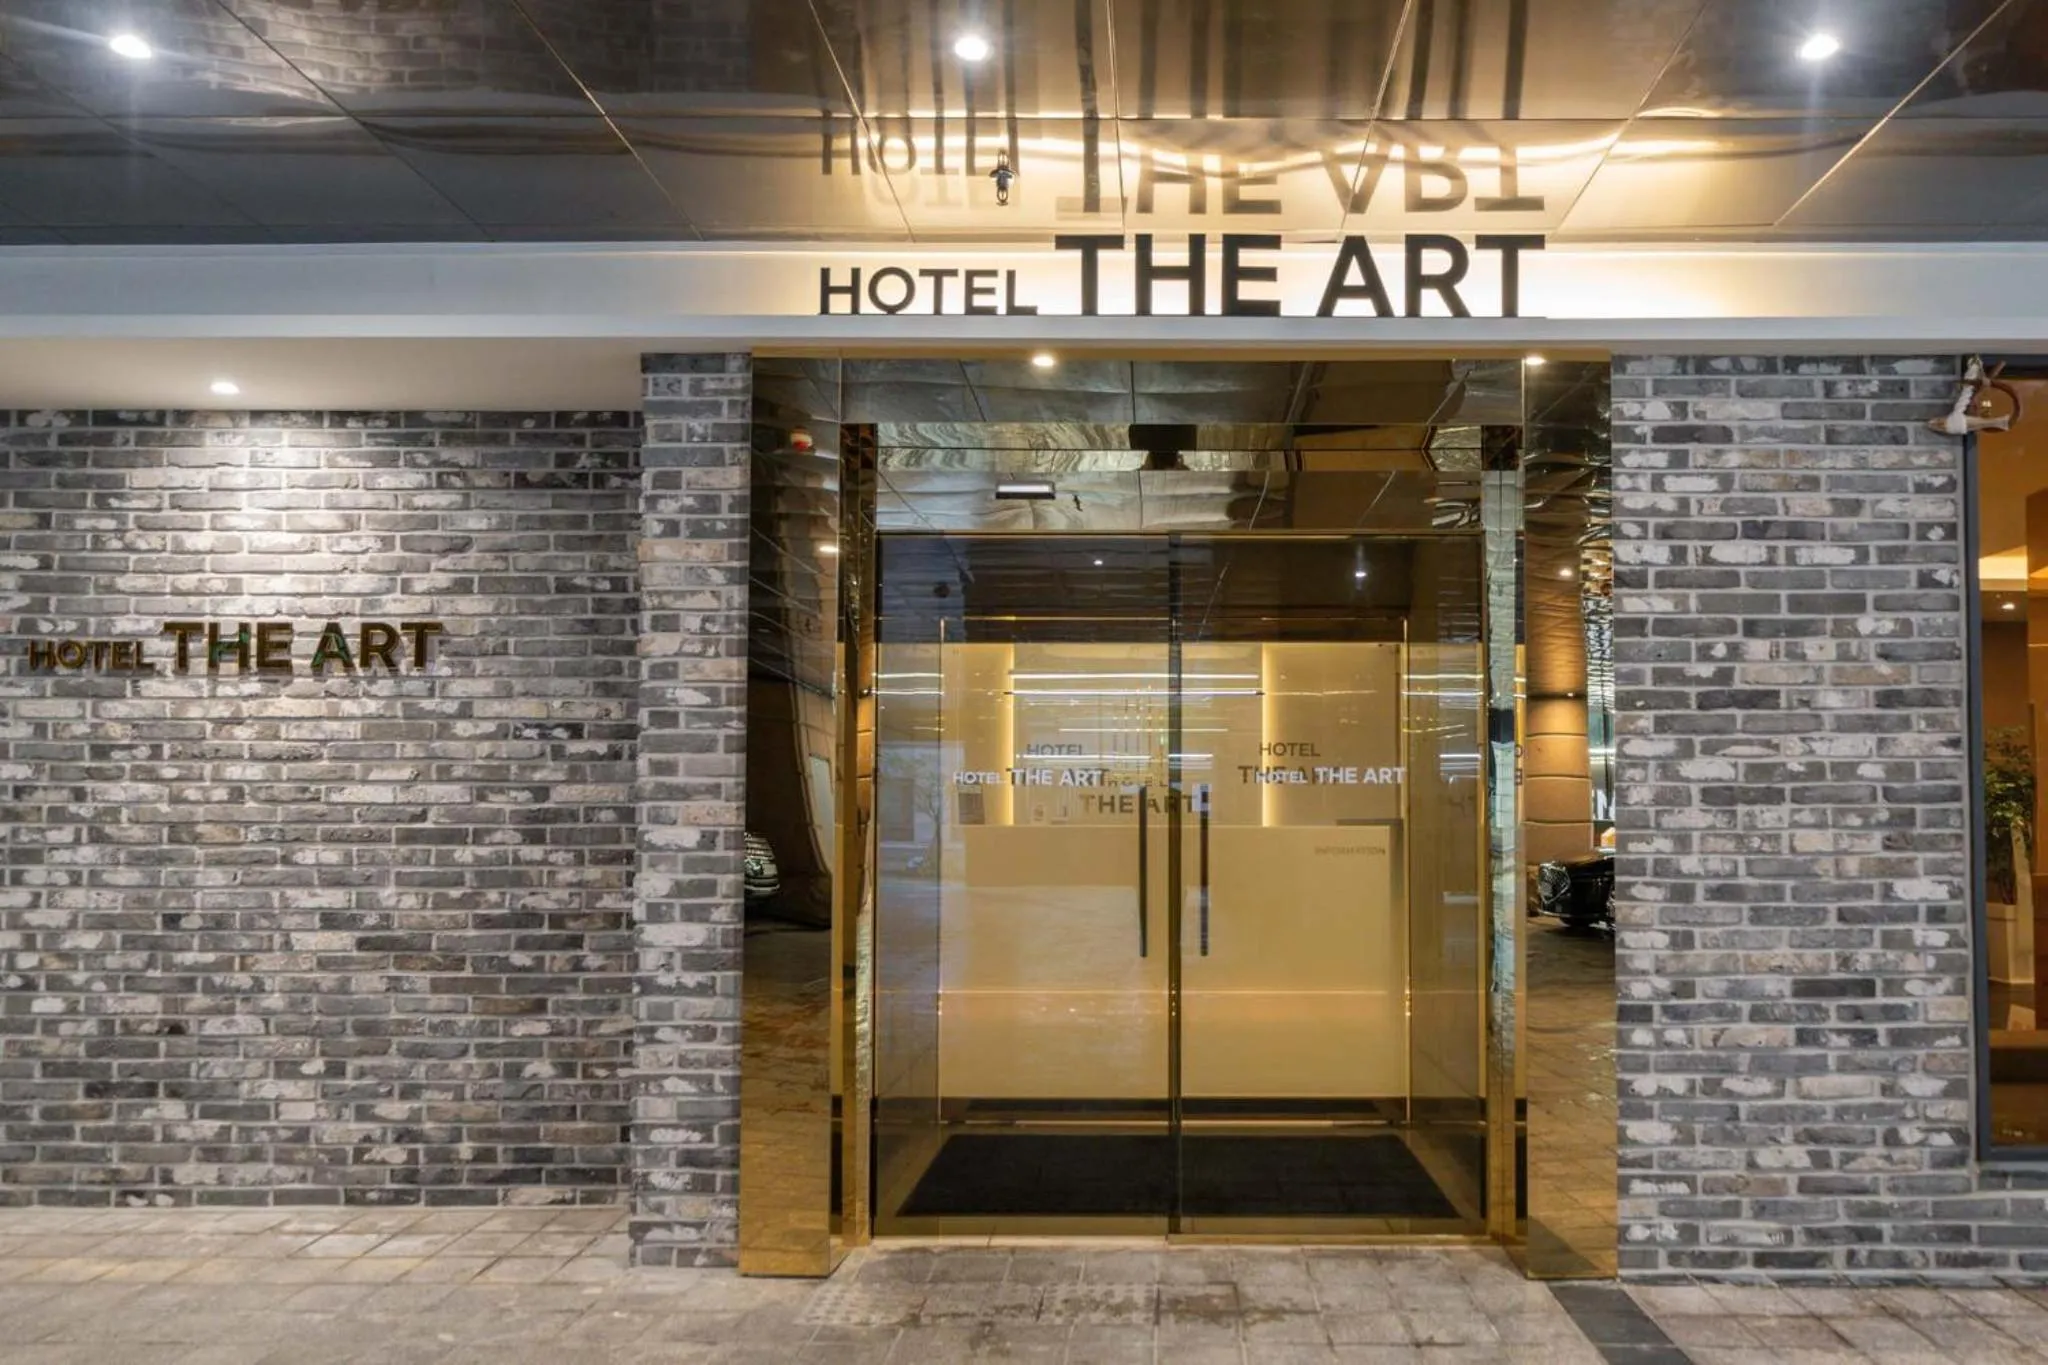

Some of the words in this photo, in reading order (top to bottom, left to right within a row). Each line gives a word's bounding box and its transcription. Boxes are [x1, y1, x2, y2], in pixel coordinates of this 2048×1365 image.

[820, 266, 1038, 316] HOTEL
[1055, 233, 1282, 317] THE
[1316, 233, 1546, 318] ART
[28, 639, 154, 669] HOTEL
[164, 621, 293, 670] THE
[311, 621, 443, 669] ART
[1259, 742, 1321, 757] HOTEL
[953, 771, 1005, 785] HOTEL
[1011, 768, 1054, 785] THE
[1059, 769, 1102, 786] ART
[1255, 771, 1308, 784] HOTEL
[1314, 767, 1358, 784] THE
[1363, 766, 1406, 784] ART
